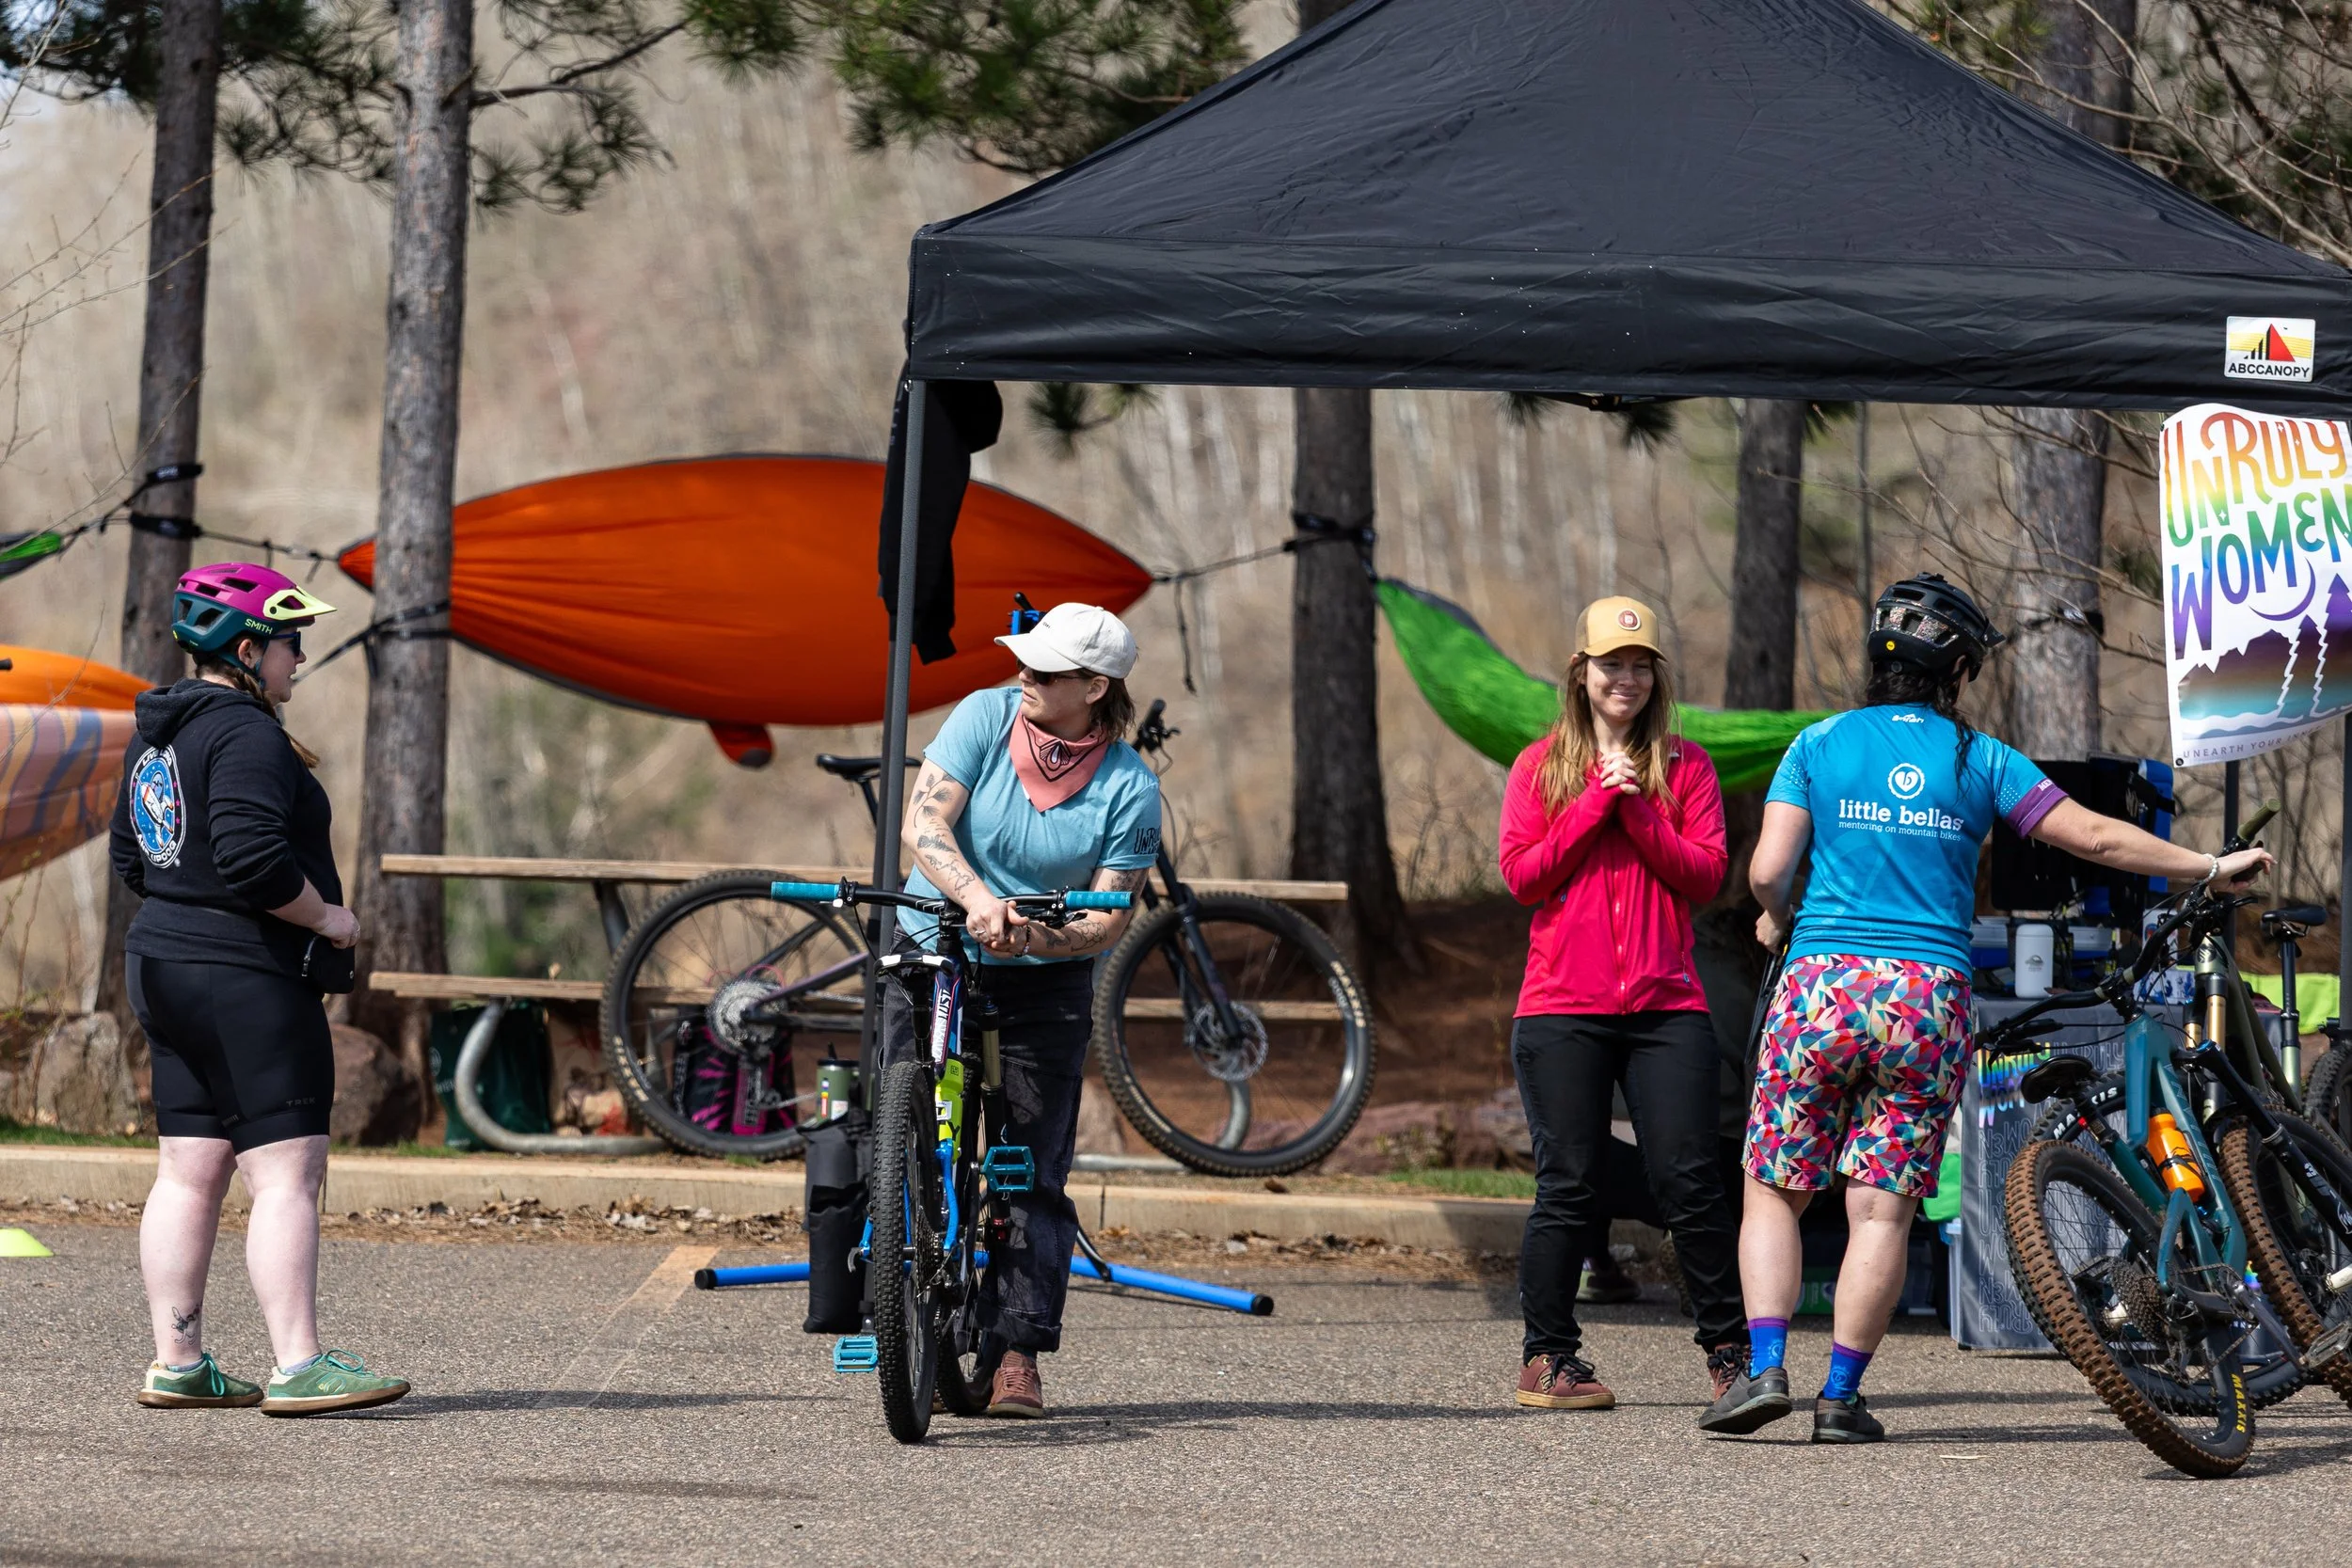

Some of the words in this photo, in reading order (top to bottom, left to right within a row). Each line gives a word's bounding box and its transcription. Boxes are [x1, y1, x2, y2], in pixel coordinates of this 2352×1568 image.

[2228, 363, 2310, 378] ABCCANOPY
[2164, 411, 2347, 547] UNRULY
[2170, 483, 2352, 660] WOMEN
[245, 618, 274, 635] SMITH
[2183, 743, 2245, 759] UNEARTH
[2249, 736, 2283, 751] YOUR
[1838, 799, 1892, 823] little
[1898, 805, 1964, 832] bellas
[1838, 820, 1883, 833] mentoring
[1884, 825, 1897, 833] on
[1899, 827, 1938, 838] mountain
[1939, 830, 1962, 842] bikes
[285, 1096, 317, 1107] TREK
[2053, 1086, 2118, 1140] MAIS
[2231, 1373, 2248, 1433] MAXXIS
